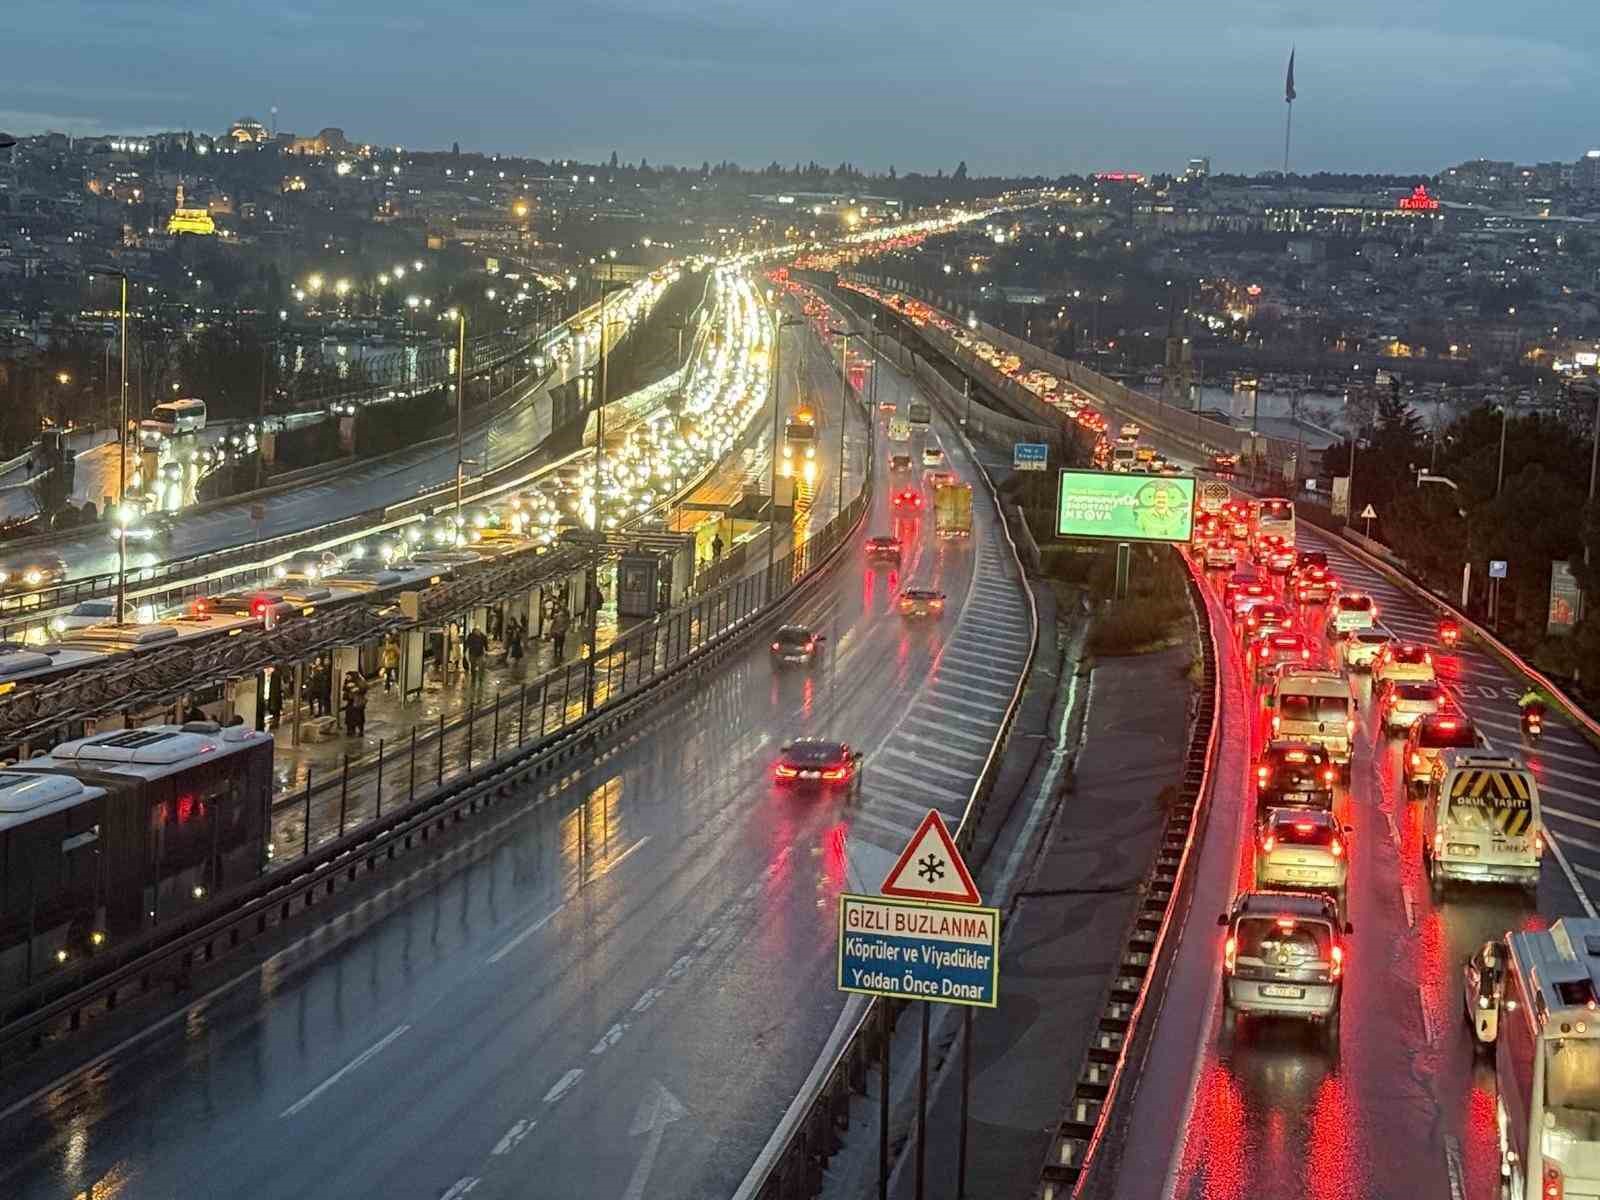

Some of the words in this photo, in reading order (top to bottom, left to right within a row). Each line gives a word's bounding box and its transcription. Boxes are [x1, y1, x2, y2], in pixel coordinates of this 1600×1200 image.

[1451, 684, 1521, 700] EDS
[1457, 796, 1487, 806] OKUL
[849, 905, 889, 931] GİZLİ
[895, 913, 988, 939] BUZLANMA
[846, 937, 900, 962] Köprüler
[903, 947, 918, 962] ve
[921, 945, 991, 970] Viyadükler
[852, 968, 899, 991] Yoldan
[903, 970, 939, 995] Önce
[942, 979, 985, 1000] Donar
